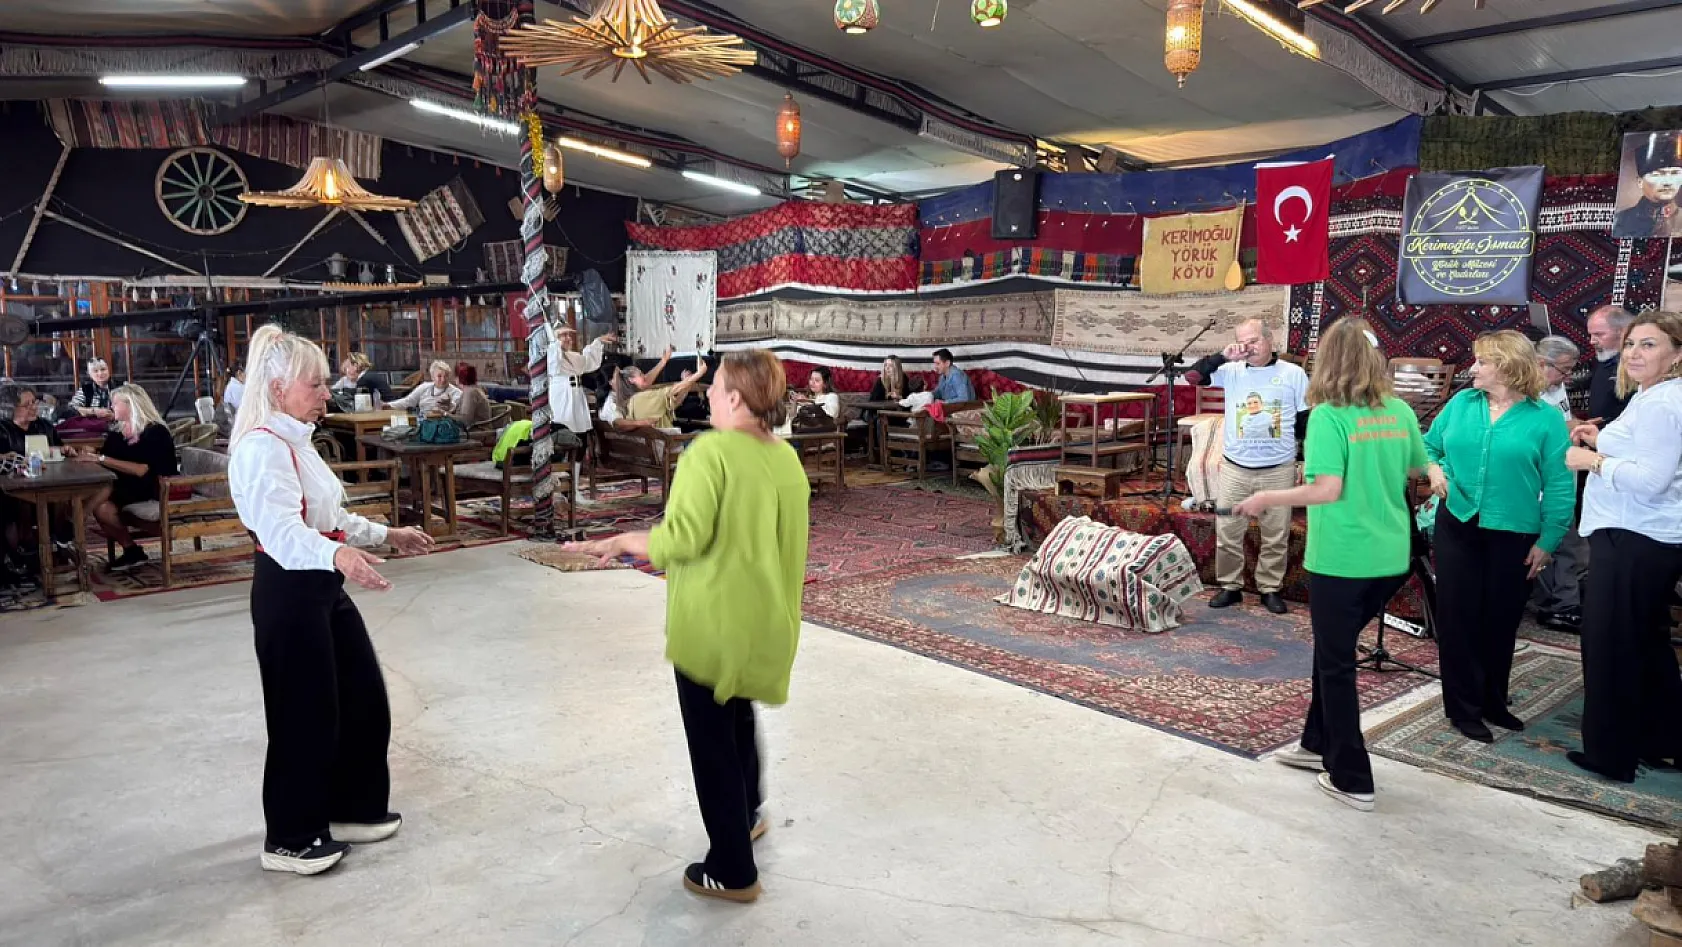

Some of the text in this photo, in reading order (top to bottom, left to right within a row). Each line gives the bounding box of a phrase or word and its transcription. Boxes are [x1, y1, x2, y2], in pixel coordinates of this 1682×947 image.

[1161, 224, 1233, 245] KERİMOĞLU
[1171, 243, 1218, 262] YÖRÜK
[1407, 235, 1530, 255] Kerimoğlu İsmail
[1172, 263, 1214, 280] KÖYÜ
